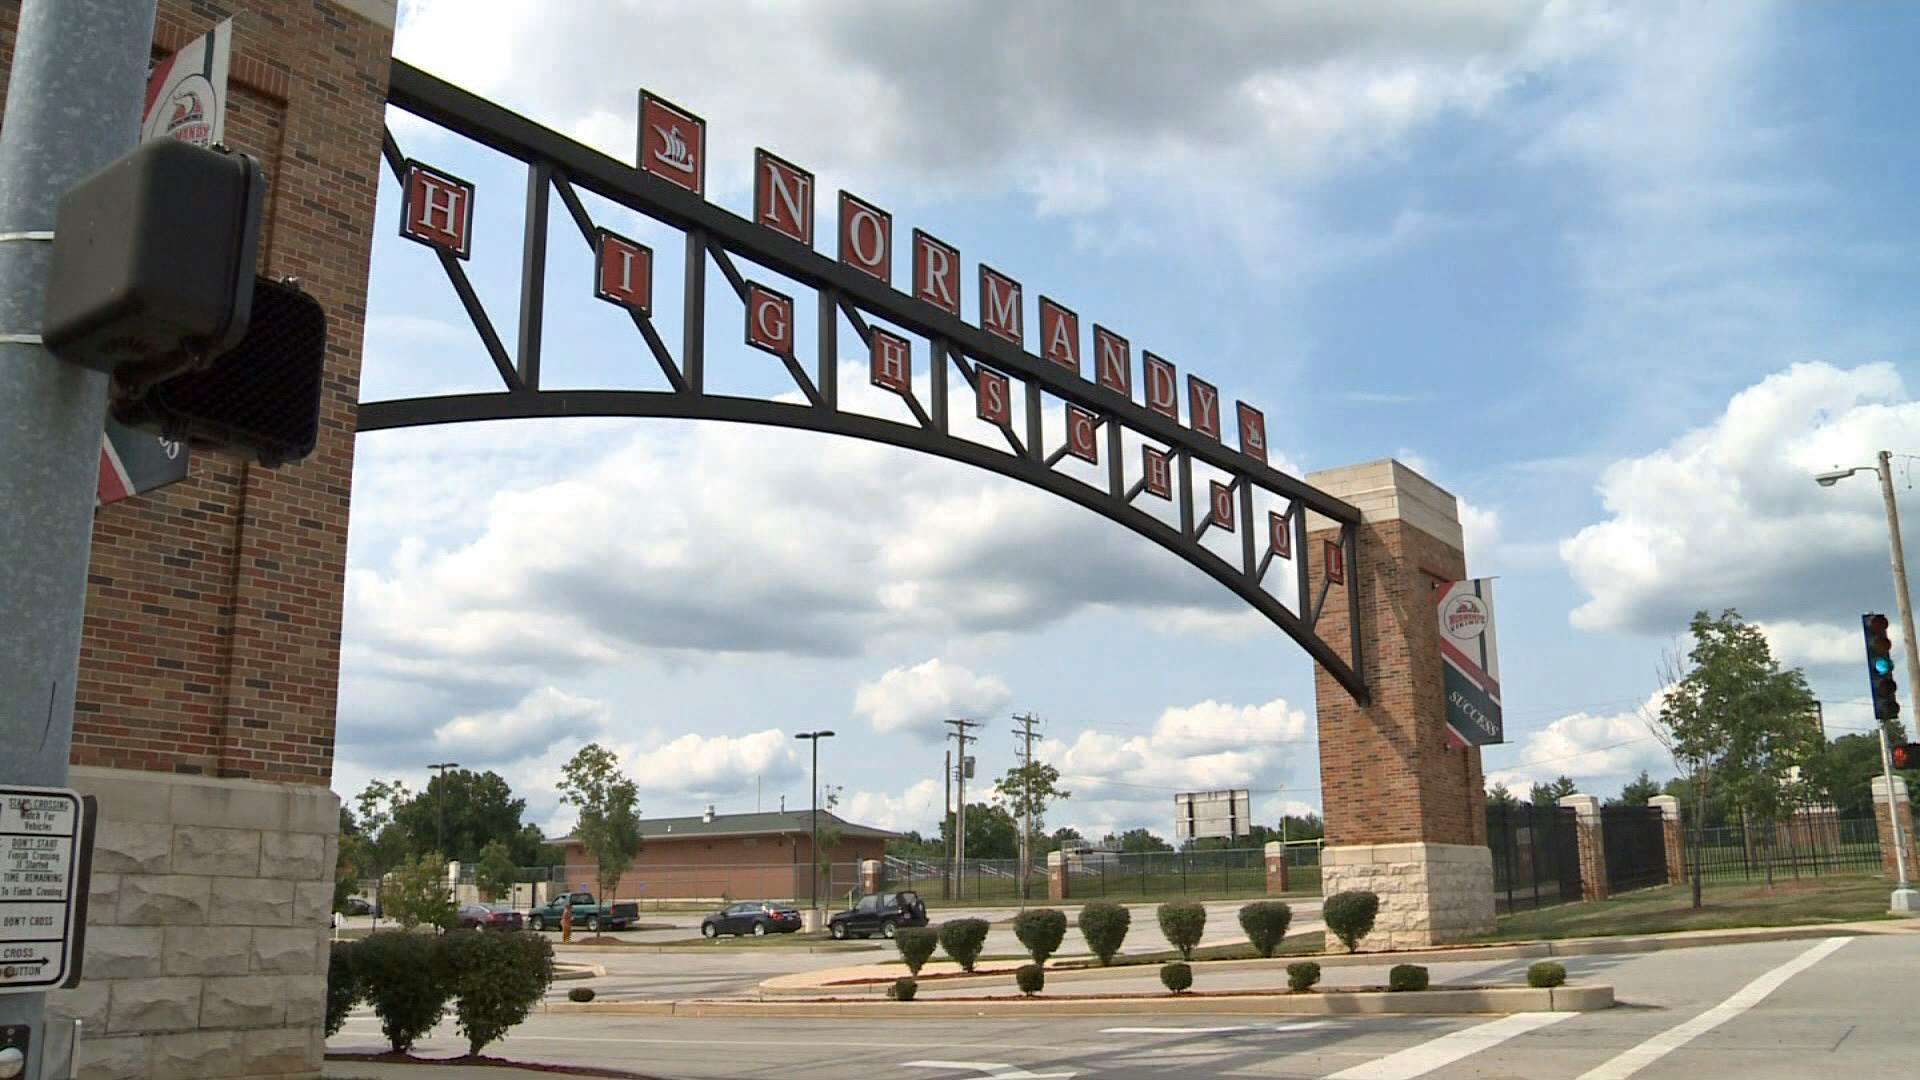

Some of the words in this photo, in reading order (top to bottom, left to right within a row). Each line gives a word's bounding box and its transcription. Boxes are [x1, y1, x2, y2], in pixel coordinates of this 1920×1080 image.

[765, 163, 1216, 431] NORMANDY
[418, 180, 904, 380] HIGH
[988, 380, 1341, 581] SCHOOL
[1449, 691, 1498, 737] SUCCESS
[33, 799, 69, 811] CROSSING
[44, 812, 55, 821] For
[24, 821, 52, 831] Vehicles
[12, 838, 34, 848] DON'T
[37, 839, 58, 849] START
[8, 850, 29, 860] Finish
[32, 852, 60, 863] Crossing
[25, 861, 49, 869] Started
[4, 873, 20, 882] TIME
[24, 873, 63, 883] REMAINING
[1, 887, 9, 896] To
[13, 887, 32, 896] Finish
[36, 887, 63, 898] Crossing
[3, 916, 27, 926] DON'T
[29, 917, 53, 926] CROSS
[4, 948, 33, 958] CROSS
[5, 966, 41, 977] UTTON
